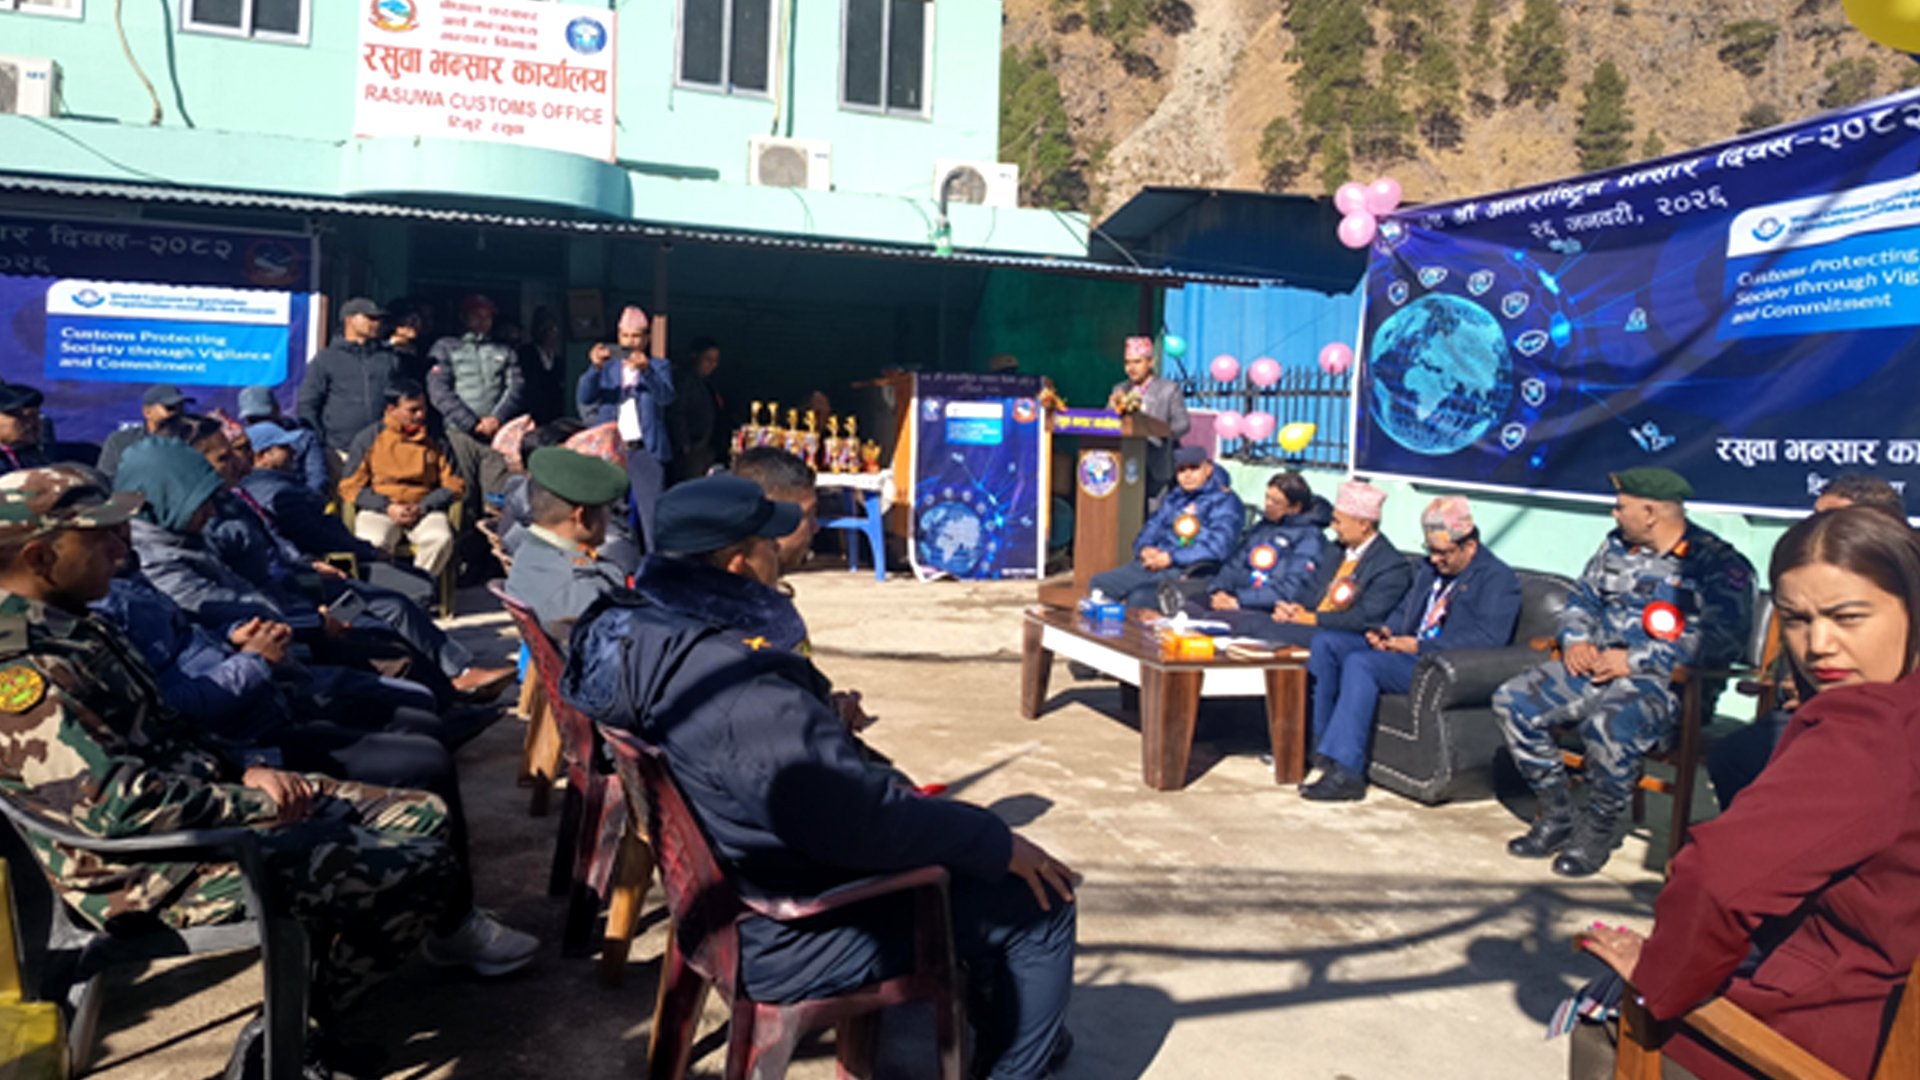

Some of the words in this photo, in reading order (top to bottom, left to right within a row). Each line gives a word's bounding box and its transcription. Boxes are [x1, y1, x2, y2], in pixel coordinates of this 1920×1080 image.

[363, 43, 422, 79] रसुवा
[429, 49, 505, 84] भन्सार
[512, 58, 607, 94] कार्यालय
[364, 83, 444, 107] RASUWA
[449, 92, 537, 118] CUSTOMS
[542, 103, 603, 125] OFFICE
[1656, 185, 1728, 216] २०२६
[1810, 247, 1920, 275] Protecting
[1794, 273, 1878, 296] through
[1761, 292, 1893, 320] Commitment
[60, 326, 136, 342] Customs
[140, 330, 227, 347] Protecting
[59, 356, 92, 369] and
[95, 356, 207, 373] Commitment
[60, 341, 125, 356] Society
[127, 344, 195, 360] through
[198, 347, 272, 362] Vigilance
[1716, 438, 1777, 467] रसुवा
[1784, 439, 1881, 465] भन्सार
